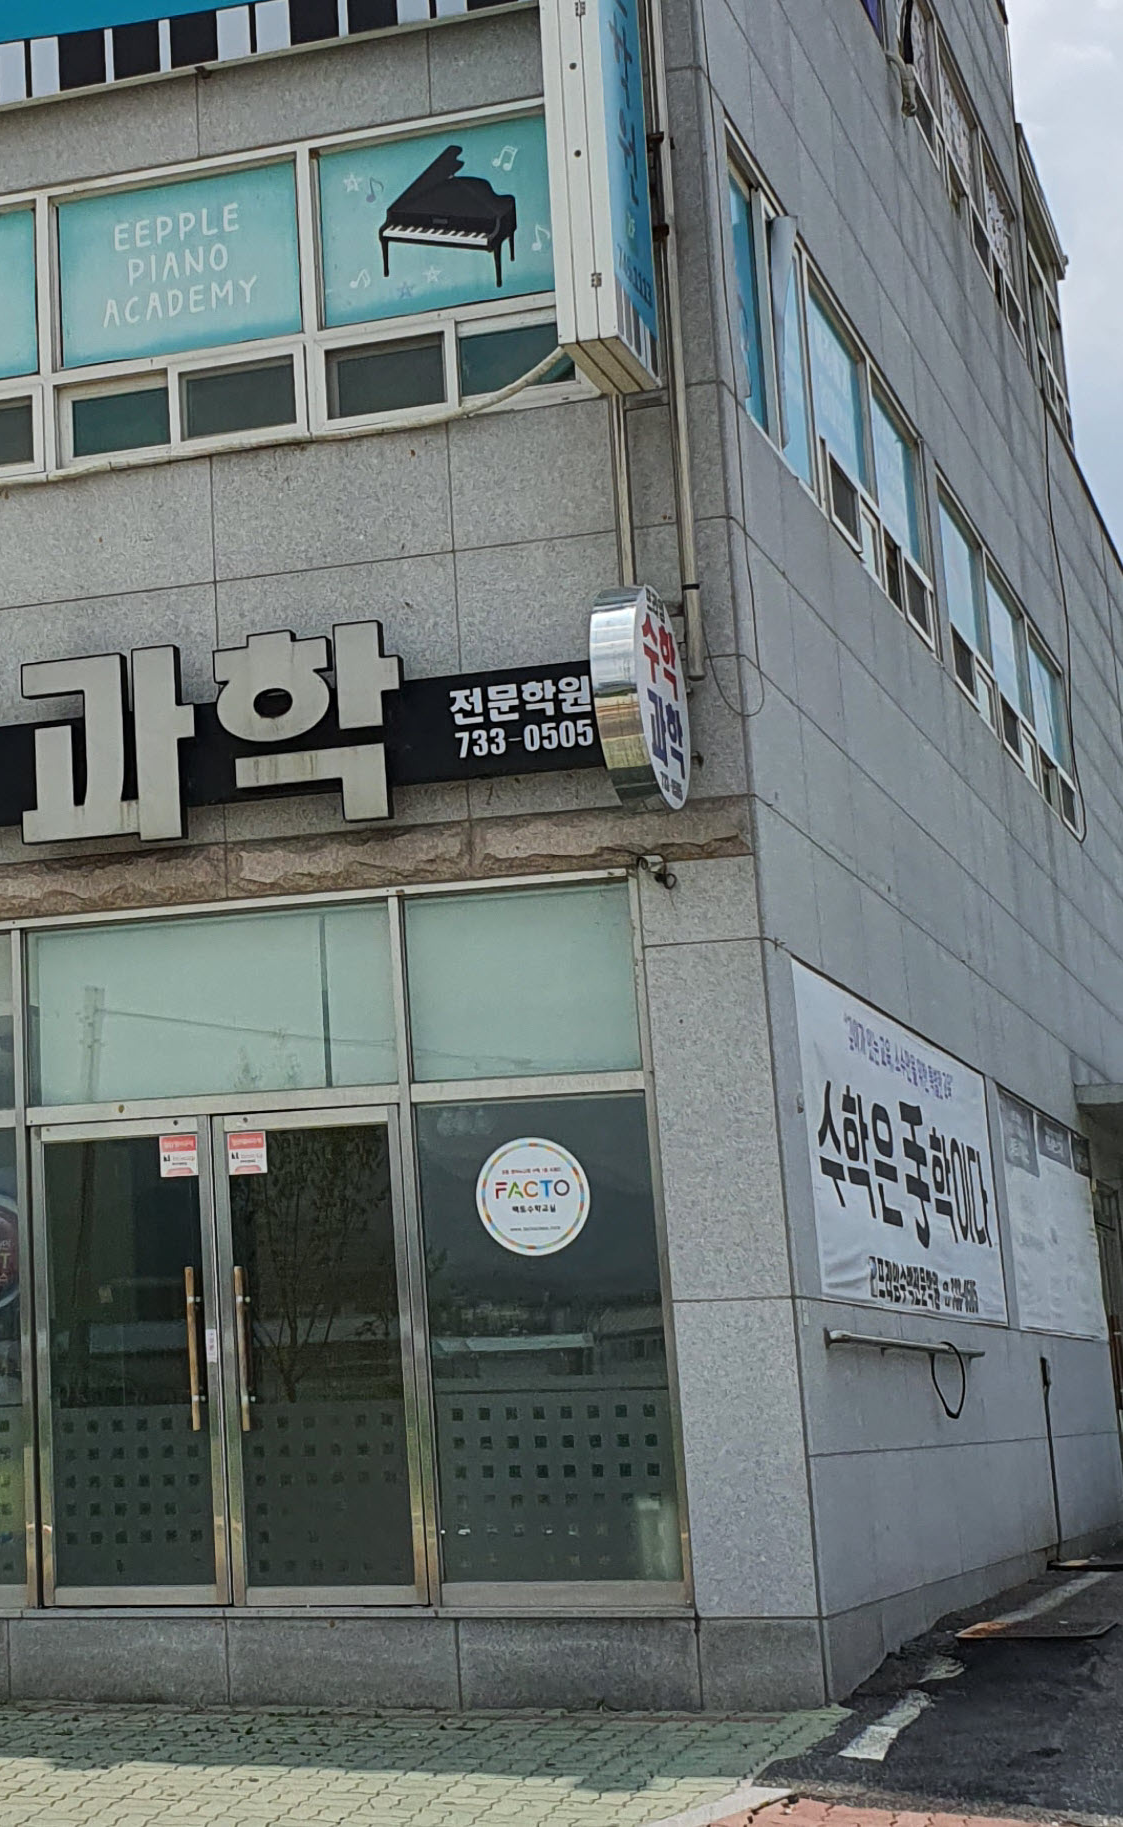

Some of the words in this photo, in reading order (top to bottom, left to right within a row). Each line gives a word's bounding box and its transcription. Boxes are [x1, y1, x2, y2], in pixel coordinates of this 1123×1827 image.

[114, 202, 239, 251] EEPPLE
[128, 243, 228, 286] PIANO
[103, 275, 257, 328] ACADEMY
[641, 613, 679, 703] 수학
[449, 675, 593, 726] 전문학원
[20, 620, 404, 846] 과학
[454, 718, 594, 759] 733-0505
[646, 689, 686, 781] 과학
[817, 1080, 904, 1228] 수학은
[495, 1179, 570, 1199] FACTO
